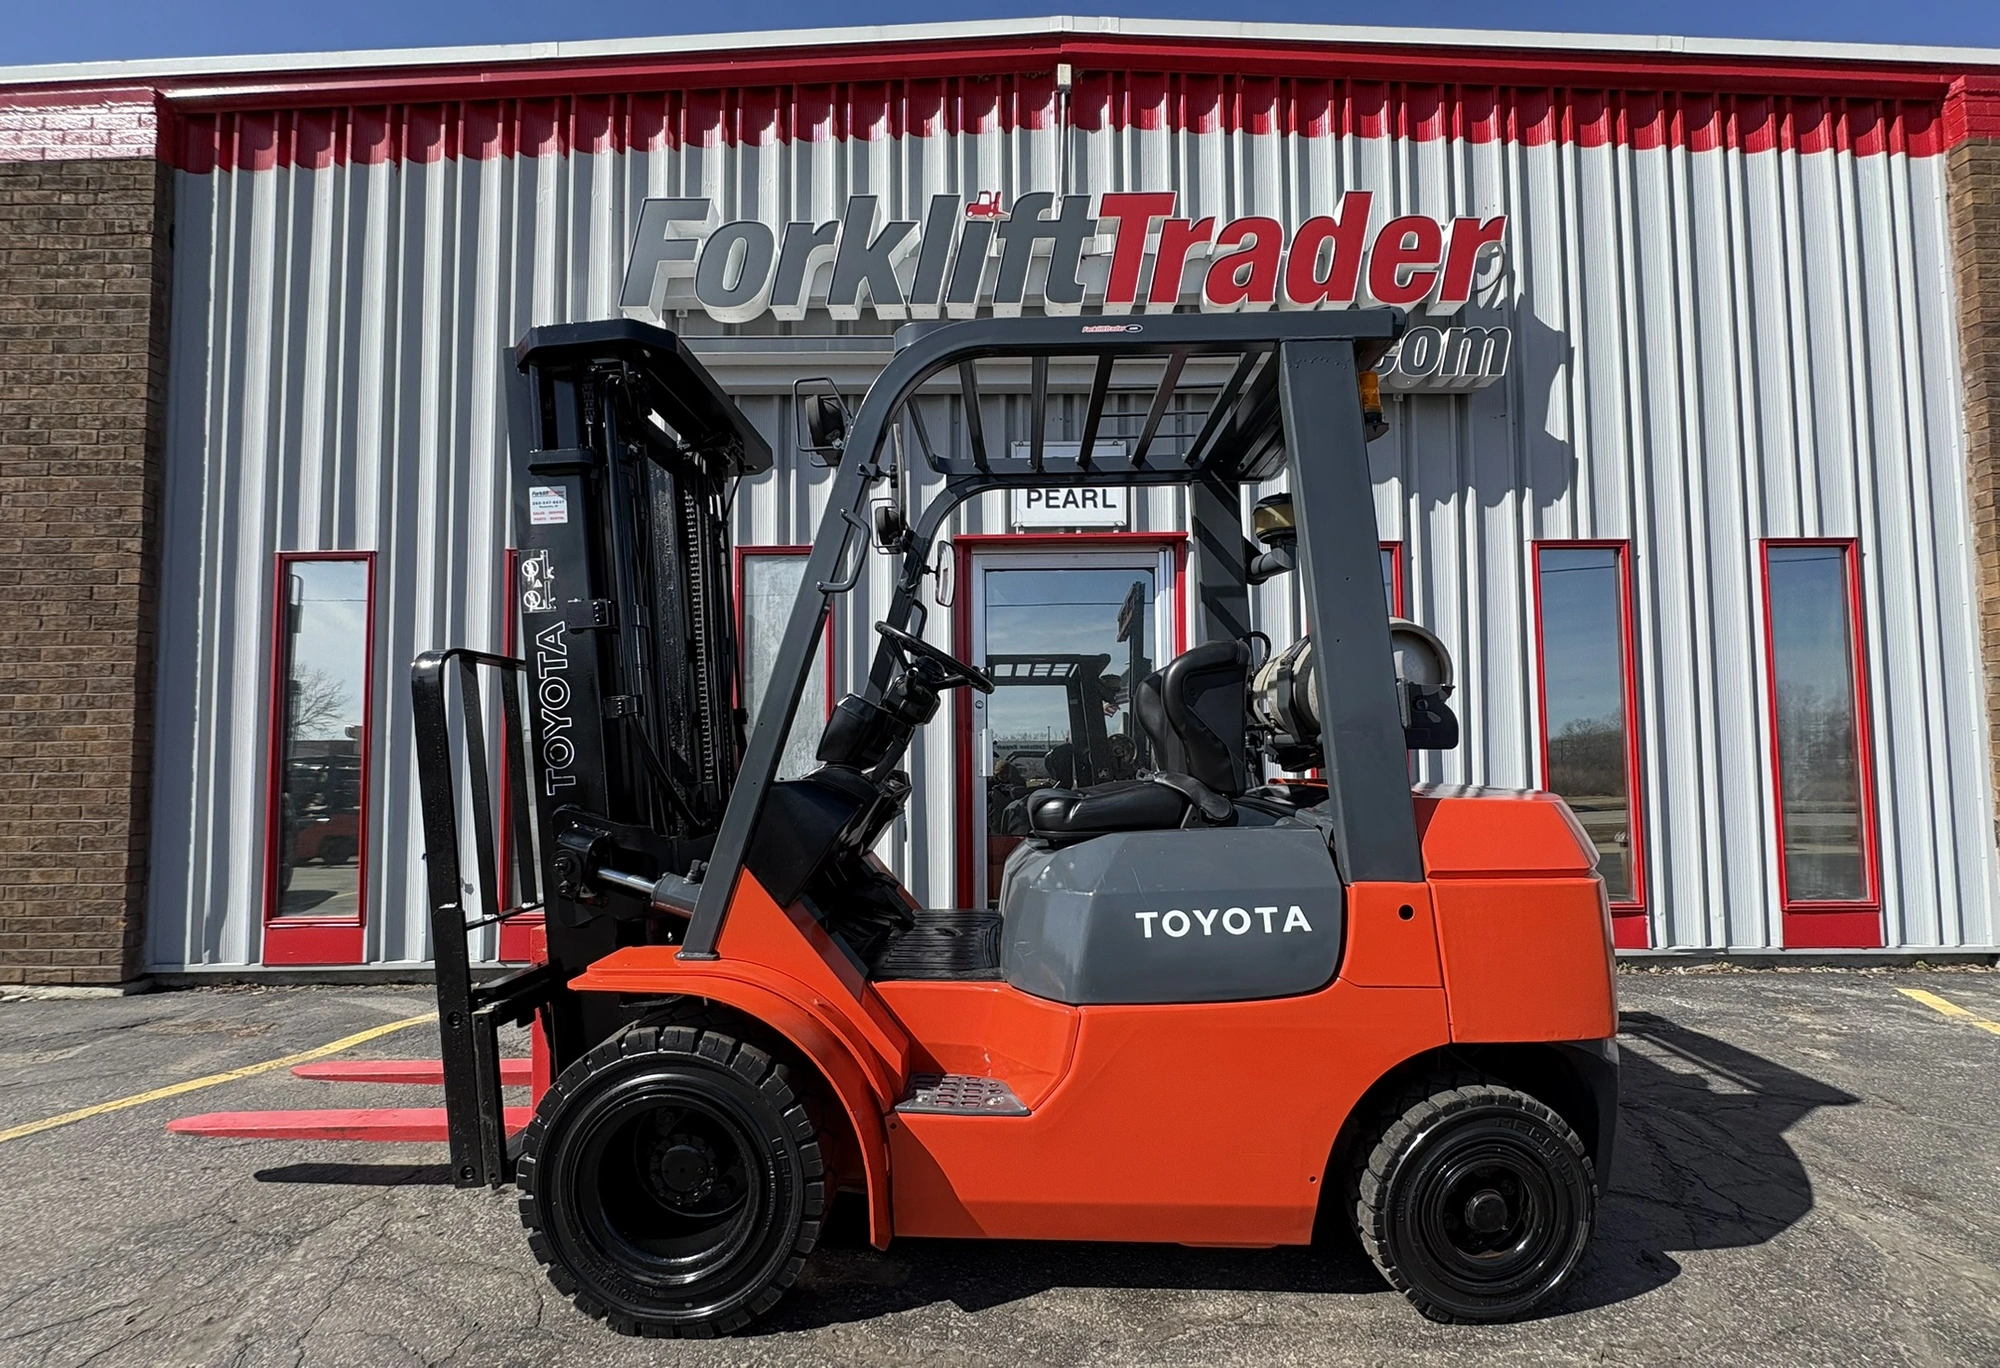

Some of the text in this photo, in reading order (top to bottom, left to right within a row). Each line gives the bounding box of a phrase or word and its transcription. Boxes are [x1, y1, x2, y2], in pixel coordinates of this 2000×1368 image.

[619, 190, 1507, 316] ForkliftTrader
[1027, 488, 1117, 509] PEARL
[536, 620, 577, 796] TOYOTA
[1135, 905, 1313, 938] TOYOTA
